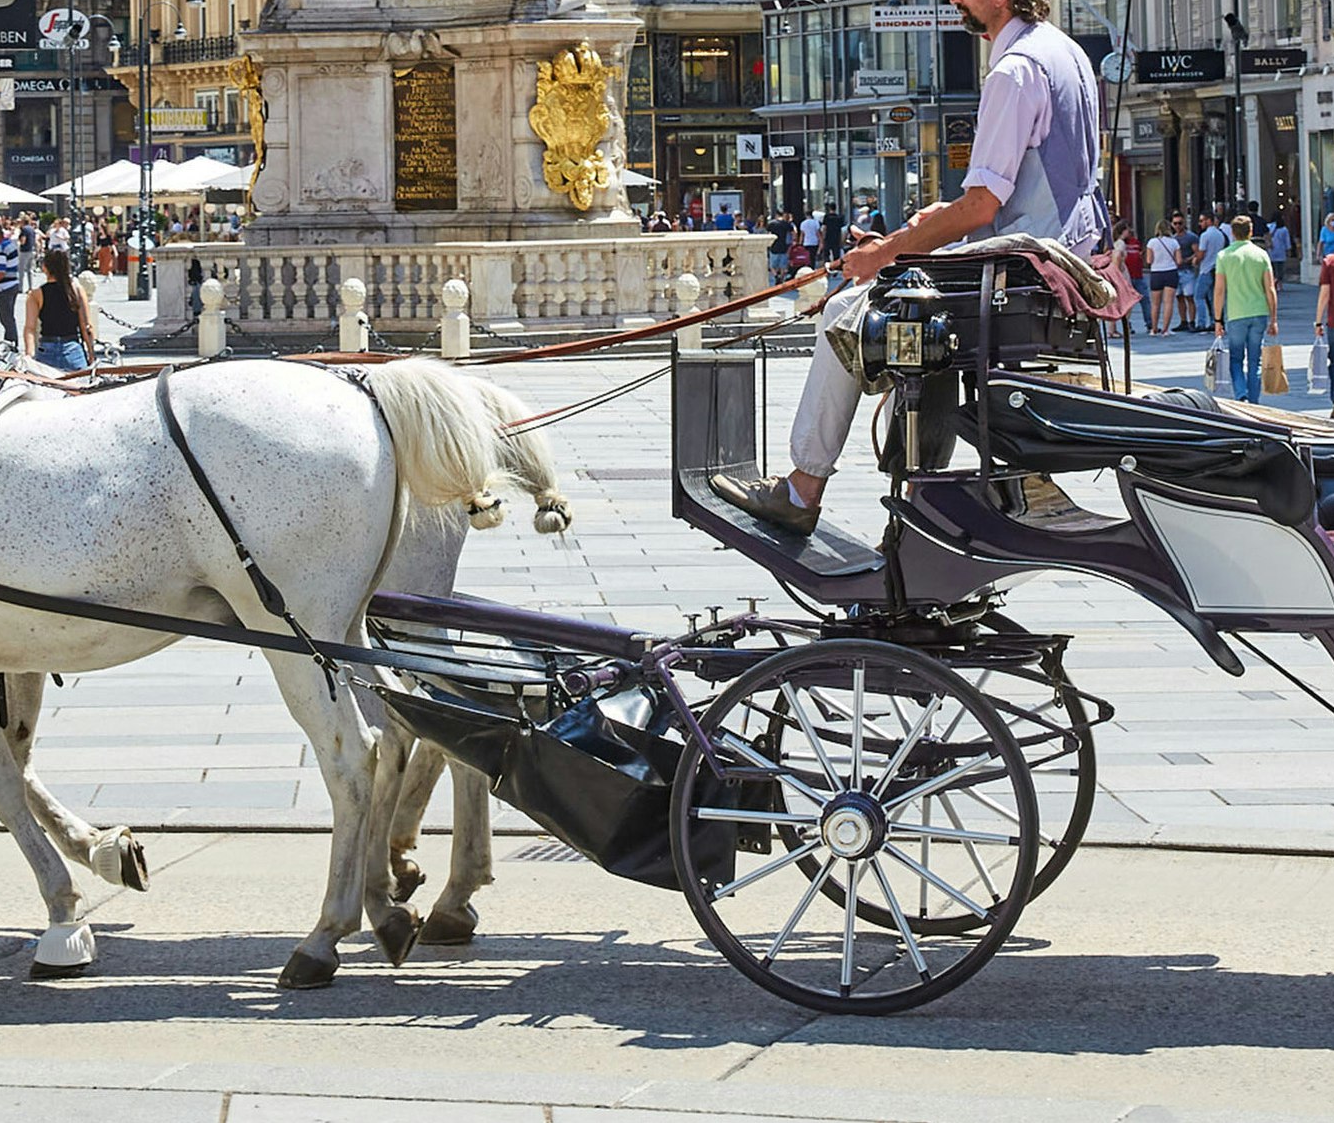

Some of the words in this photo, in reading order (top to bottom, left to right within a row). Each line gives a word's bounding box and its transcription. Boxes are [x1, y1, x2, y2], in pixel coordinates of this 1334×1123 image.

[1160, 55, 1192, 69] IWC
[1254, 57, 1288, 66] BALLY
[14, 78, 56, 92] OMEGA
